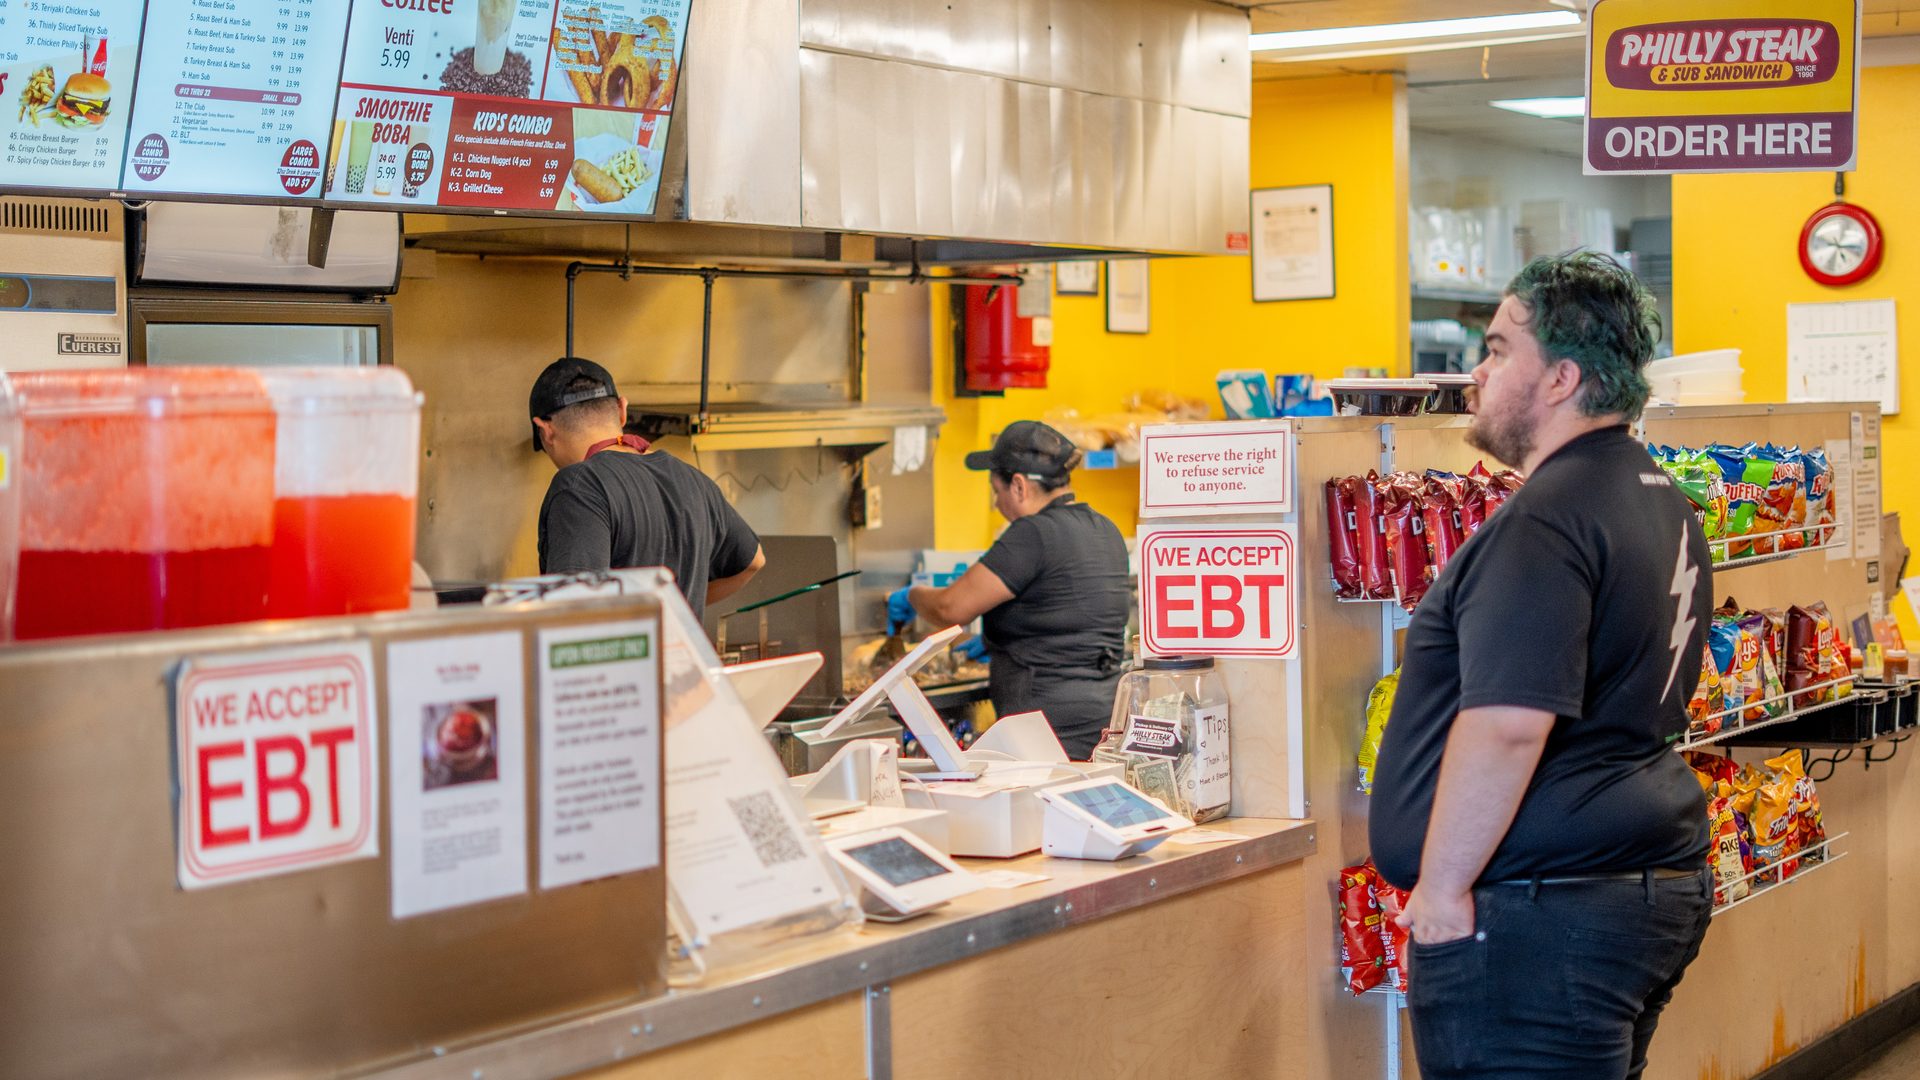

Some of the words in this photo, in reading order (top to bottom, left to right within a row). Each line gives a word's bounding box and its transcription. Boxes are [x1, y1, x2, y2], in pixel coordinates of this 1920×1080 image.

[30, 3, 39, 11] 35.
[41, 4, 63, 13] Teriyaki
[65, 6, 87, 15] Chicken
[90, 8, 100, 17] Sub
[28, 19, 37, 28] 36.
[39, 21, 56, 31] Thinly
[58, 23, 75, 31] Sliced
[77, 25, 95, 35] Turkey
[97, 27, 108, 35] Sub
[190, 13, 195, 21] 5.
[196, 14, 210, 22] Roast
[294, 24, 308, 32] 13.99
[26, 37, 35, 45] 37.
[37, 38, 60, 47] Chicken
[62, 40, 78, 50] Philly
[194, 29, 208, 37] Roast
[240, 34, 256, 43] Turkey
[256, 35, 266, 43] Sub
[272, 36, 286, 45] 10.99
[292, 38, 306, 47] 14.99
[385, 26, 414, 46] Venti
[1620, 30, 1724, 66] PHILLY
[1724, 26, 1824, 64] STEAK
[190, 57, 206, 66] Turkey
[207, 59, 223, 67] Breast
[229, 61, 240, 69] Ham
[241, 62, 251, 70] Sub
[288, 66, 302, 74] 13.99
[380, 48, 411, 69] 5.99
[182, 71, 187, 79] 9.
[200, 73, 210, 81] Sub
[286, 80, 300, 88] 13.99
[1658, 67, 1668, 81] &
[1672, 65, 1701, 82] SUB
[1704, 64, 1783, 81] SANDWICH
[190, 87, 204, 96] THRU
[262, 94, 278, 102] SMALL
[283, 95, 298, 103] LARGE
[184, 102, 193, 110] The
[194, 103, 205, 111] Club
[261, 108, 275, 116] 10.99
[355, 97, 433, 122] SMOOTHIE
[182, 117, 208, 126] Vegetarian
[262, 122, 273, 130] 8.99
[279, 123, 292, 131] 12.99
[473, 112, 508, 132] KID'S
[508, 114, 553, 135] COMBO
[10, 132, 18, 140] 45.
[20, 133, 41, 142] Chicken
[43, 134, 60, 143] Breast
[62, 135, 79, 144] Burger
[371, 123, 411, 145] BOBA
[465, 136, 482, 144] specials
[483, 137, 499, 145] include
[510, 139, 524, 147] French
[1604, 125, 1729, 158] ORDER
[1737, 122, 1832, 155] HERE
[144, 139, 163, 147] SMALL
[19, 145, 35, 154] Crispy
[36, 146, 57, 154] Chicken
[58, 147, 77, 155] Burger
[95, 149, 107, 157] 7.99
[142, 148, 163, 157] COMBO
[292, 146, 314, 156] LARGE
[379, 154, 387, 163] 24
[388, 155, 396, 163] OZ
[412, 150, 430, 160] EXTRA
[6, 155, 16, 163] 47.
[17, 156, 31, 165] Spicy
[33, 157, 49, 166] Crispy
[50, 157, 71, 166] Chicken
[72, 159, 90, 167] Burger
[289, 157, 313, 166] COMBO
[411, 160, 428, 169] BOBA
[452, 153, 465, 162] K-1.
[468, 154, 490, 164] Chicken
[491, 155, 511, 166] Nugget
[512, 157, 519, 166] (4
[519, 157, 531, 167] pcs)
[544, 159, 558, 169] 6.99
[139, 166, 152, 174] ADD
[153, 167, 161, 175] $5
[376, 167, 396, 179] 5.99
[411, 172, 425, 182] $.75
[450, 168, 462, 177] K-2.
[465, 169, 479, 178] Corn
[480, 169, 492, 180] Dog
[542, 174, 556, 184] 6.99
[286, 178, 300, 187] ADD
[301, 178, 310, 188] $7
[448, 182, 460, 192] K-3.
[463, 183, 482, 193] Grilled
[483, 185, 504, 194] Cheese
[540, 188, 553, 197] 6.99
[1154, 451, 1173, 463] We
[1177, 452, 1220, 463] reserve
[1223, 449, 1243, 460] the
[1246, 448, 1277, 463] right
[1166, 467, 1178, 478] to
[1182, 464, 1219, 477] refuse
[1222, 463, 1265, 476] service
[1184, 481, 1196, 492] to
[1199, 481, 1246, 494] anyone.
[1154, 547, 1191, 567] WE
[1196, 546, 1283, 566] ACCEPT
[1155, 575, 1285, 639] EBT
[193, 694, 238, 729] WE
[245, 681, 354, 724] ACCEPT
[1203, 715, 1226, 741] Tips
[1152, 732, 1171, 740] STEAK
[1203, 754, 1220, 768] Thank
[197, 726, 355, 850] EBT
